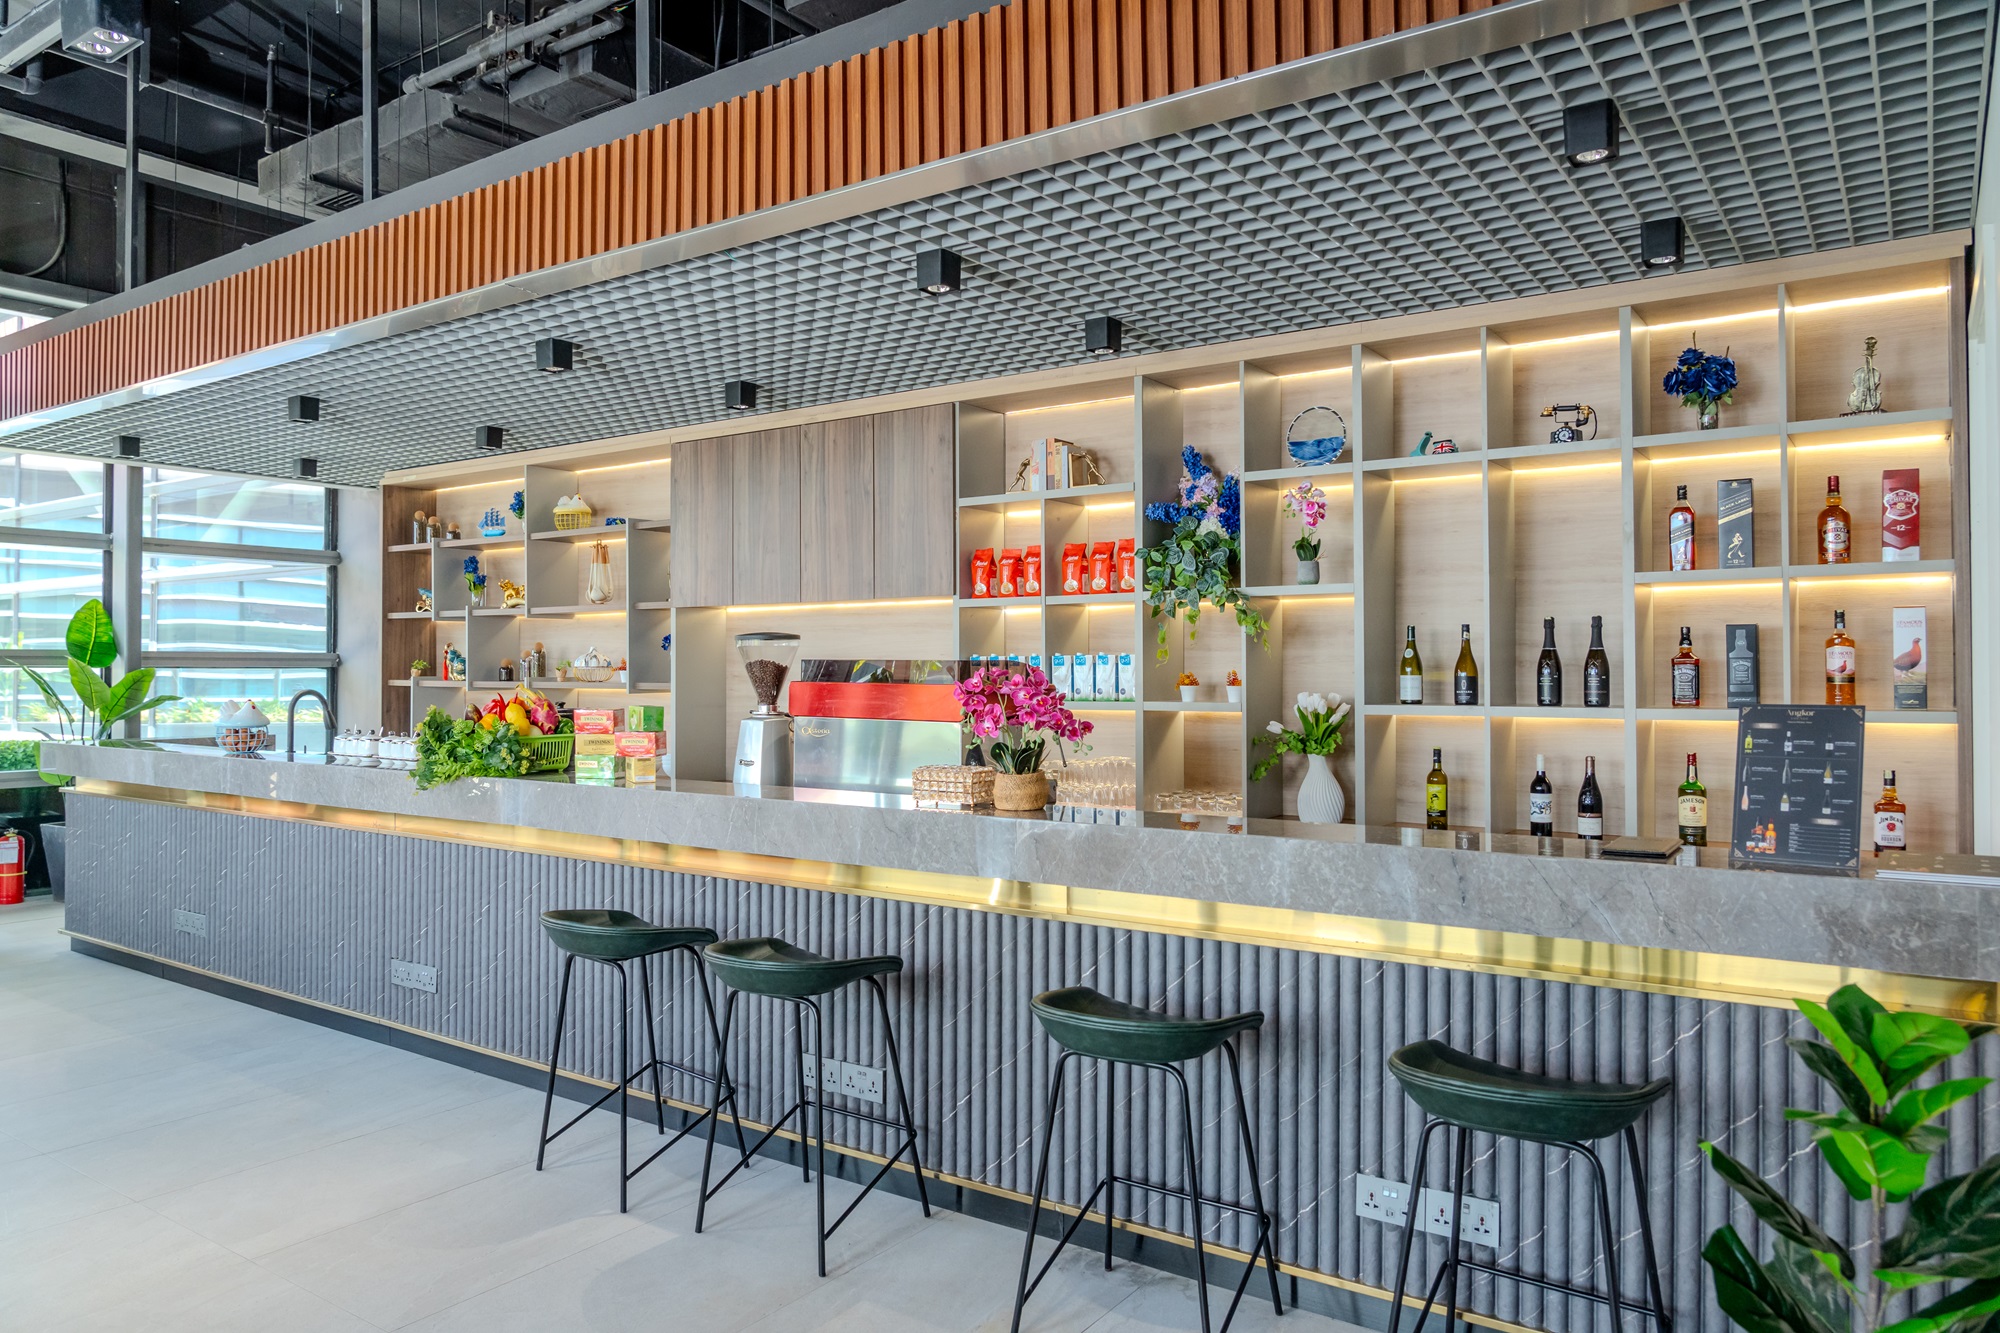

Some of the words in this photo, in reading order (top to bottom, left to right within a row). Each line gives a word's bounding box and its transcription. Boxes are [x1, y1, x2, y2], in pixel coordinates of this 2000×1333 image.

[1720, 502, 1735, 511] BLACK
[1735, 496, 1749, 505] LABEL
[1787, 709, 1815, 717] Angkor
[1680, 797, 1705, 805] JAMESON
[1879, 816, 1889, 824] JIM
[1889, 815, 1904, 825] BEAM
